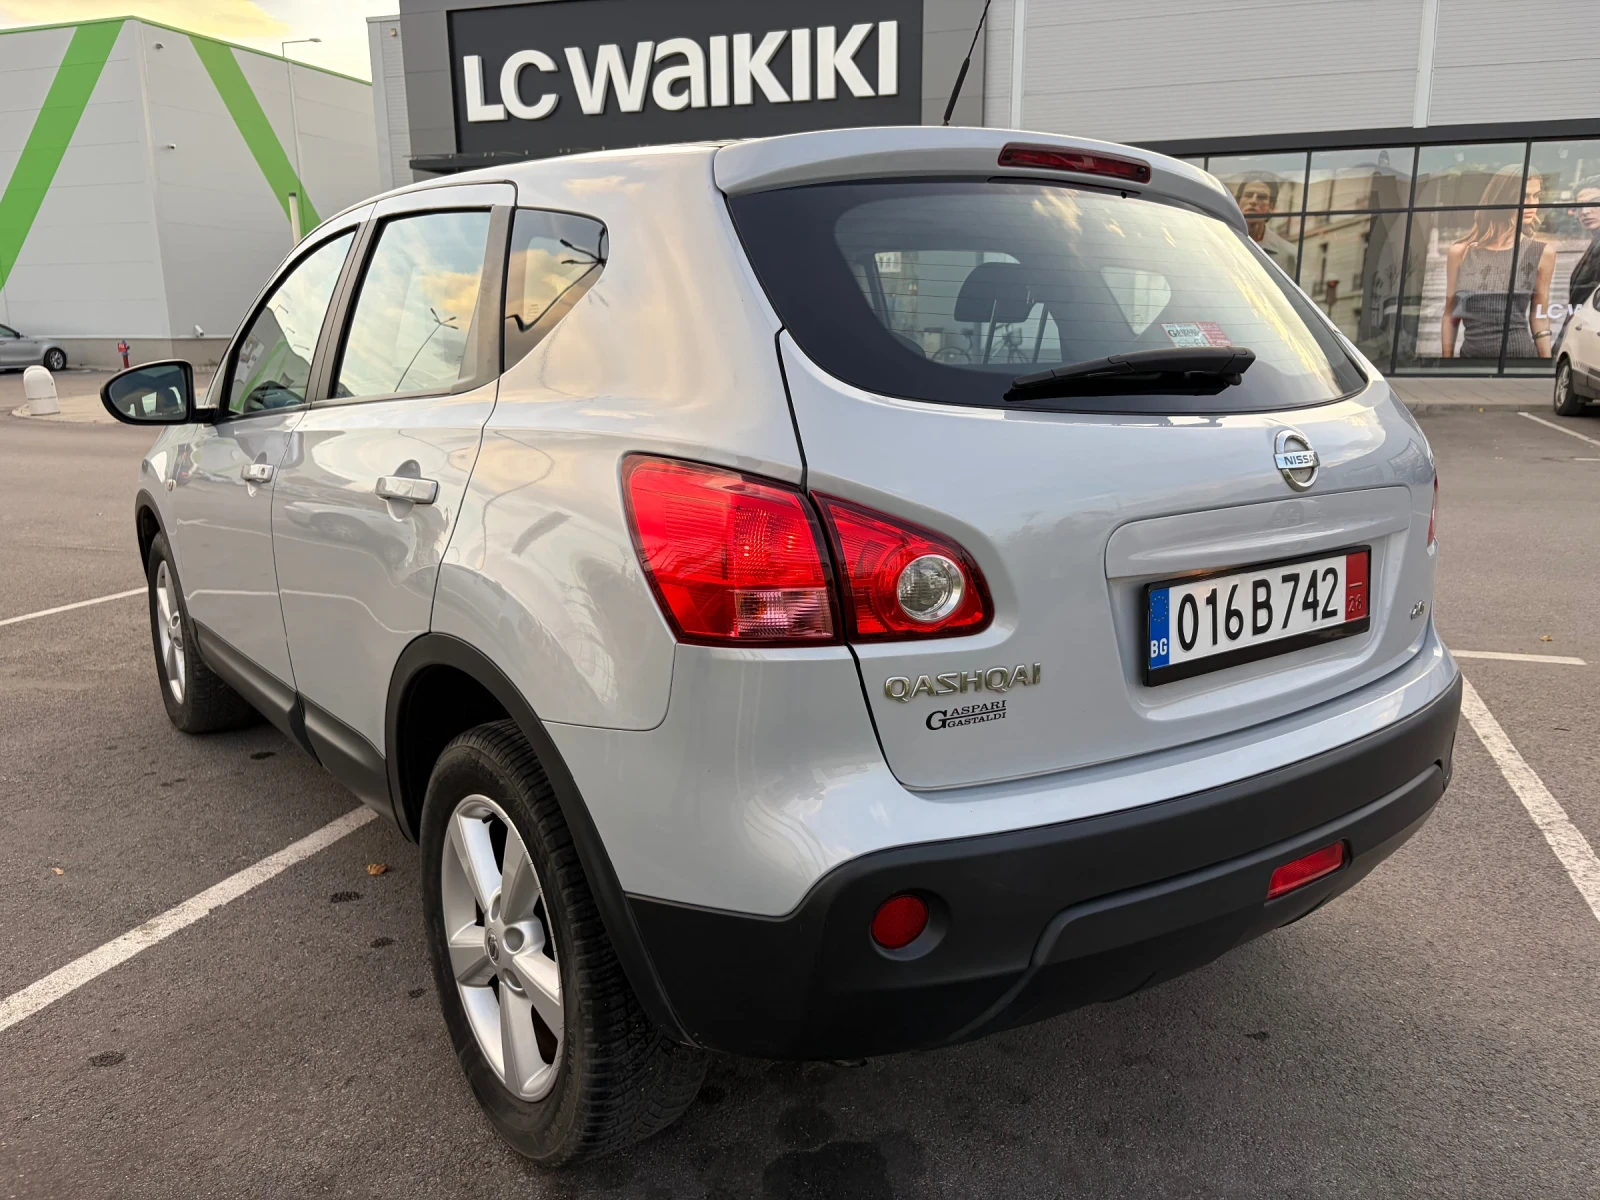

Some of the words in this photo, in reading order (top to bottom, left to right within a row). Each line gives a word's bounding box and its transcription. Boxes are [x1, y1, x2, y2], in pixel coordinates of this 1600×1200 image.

[463, 49, 557, 122] LC
[1535, 303, 1564, 319] LC
[1177, 567, 1338, 651] 016B742
[1150, 638, 1168, 658] BG
[884, 662, 1041, 703] QASHQAI
[947, 711, 1007, 728] GASTALDI
